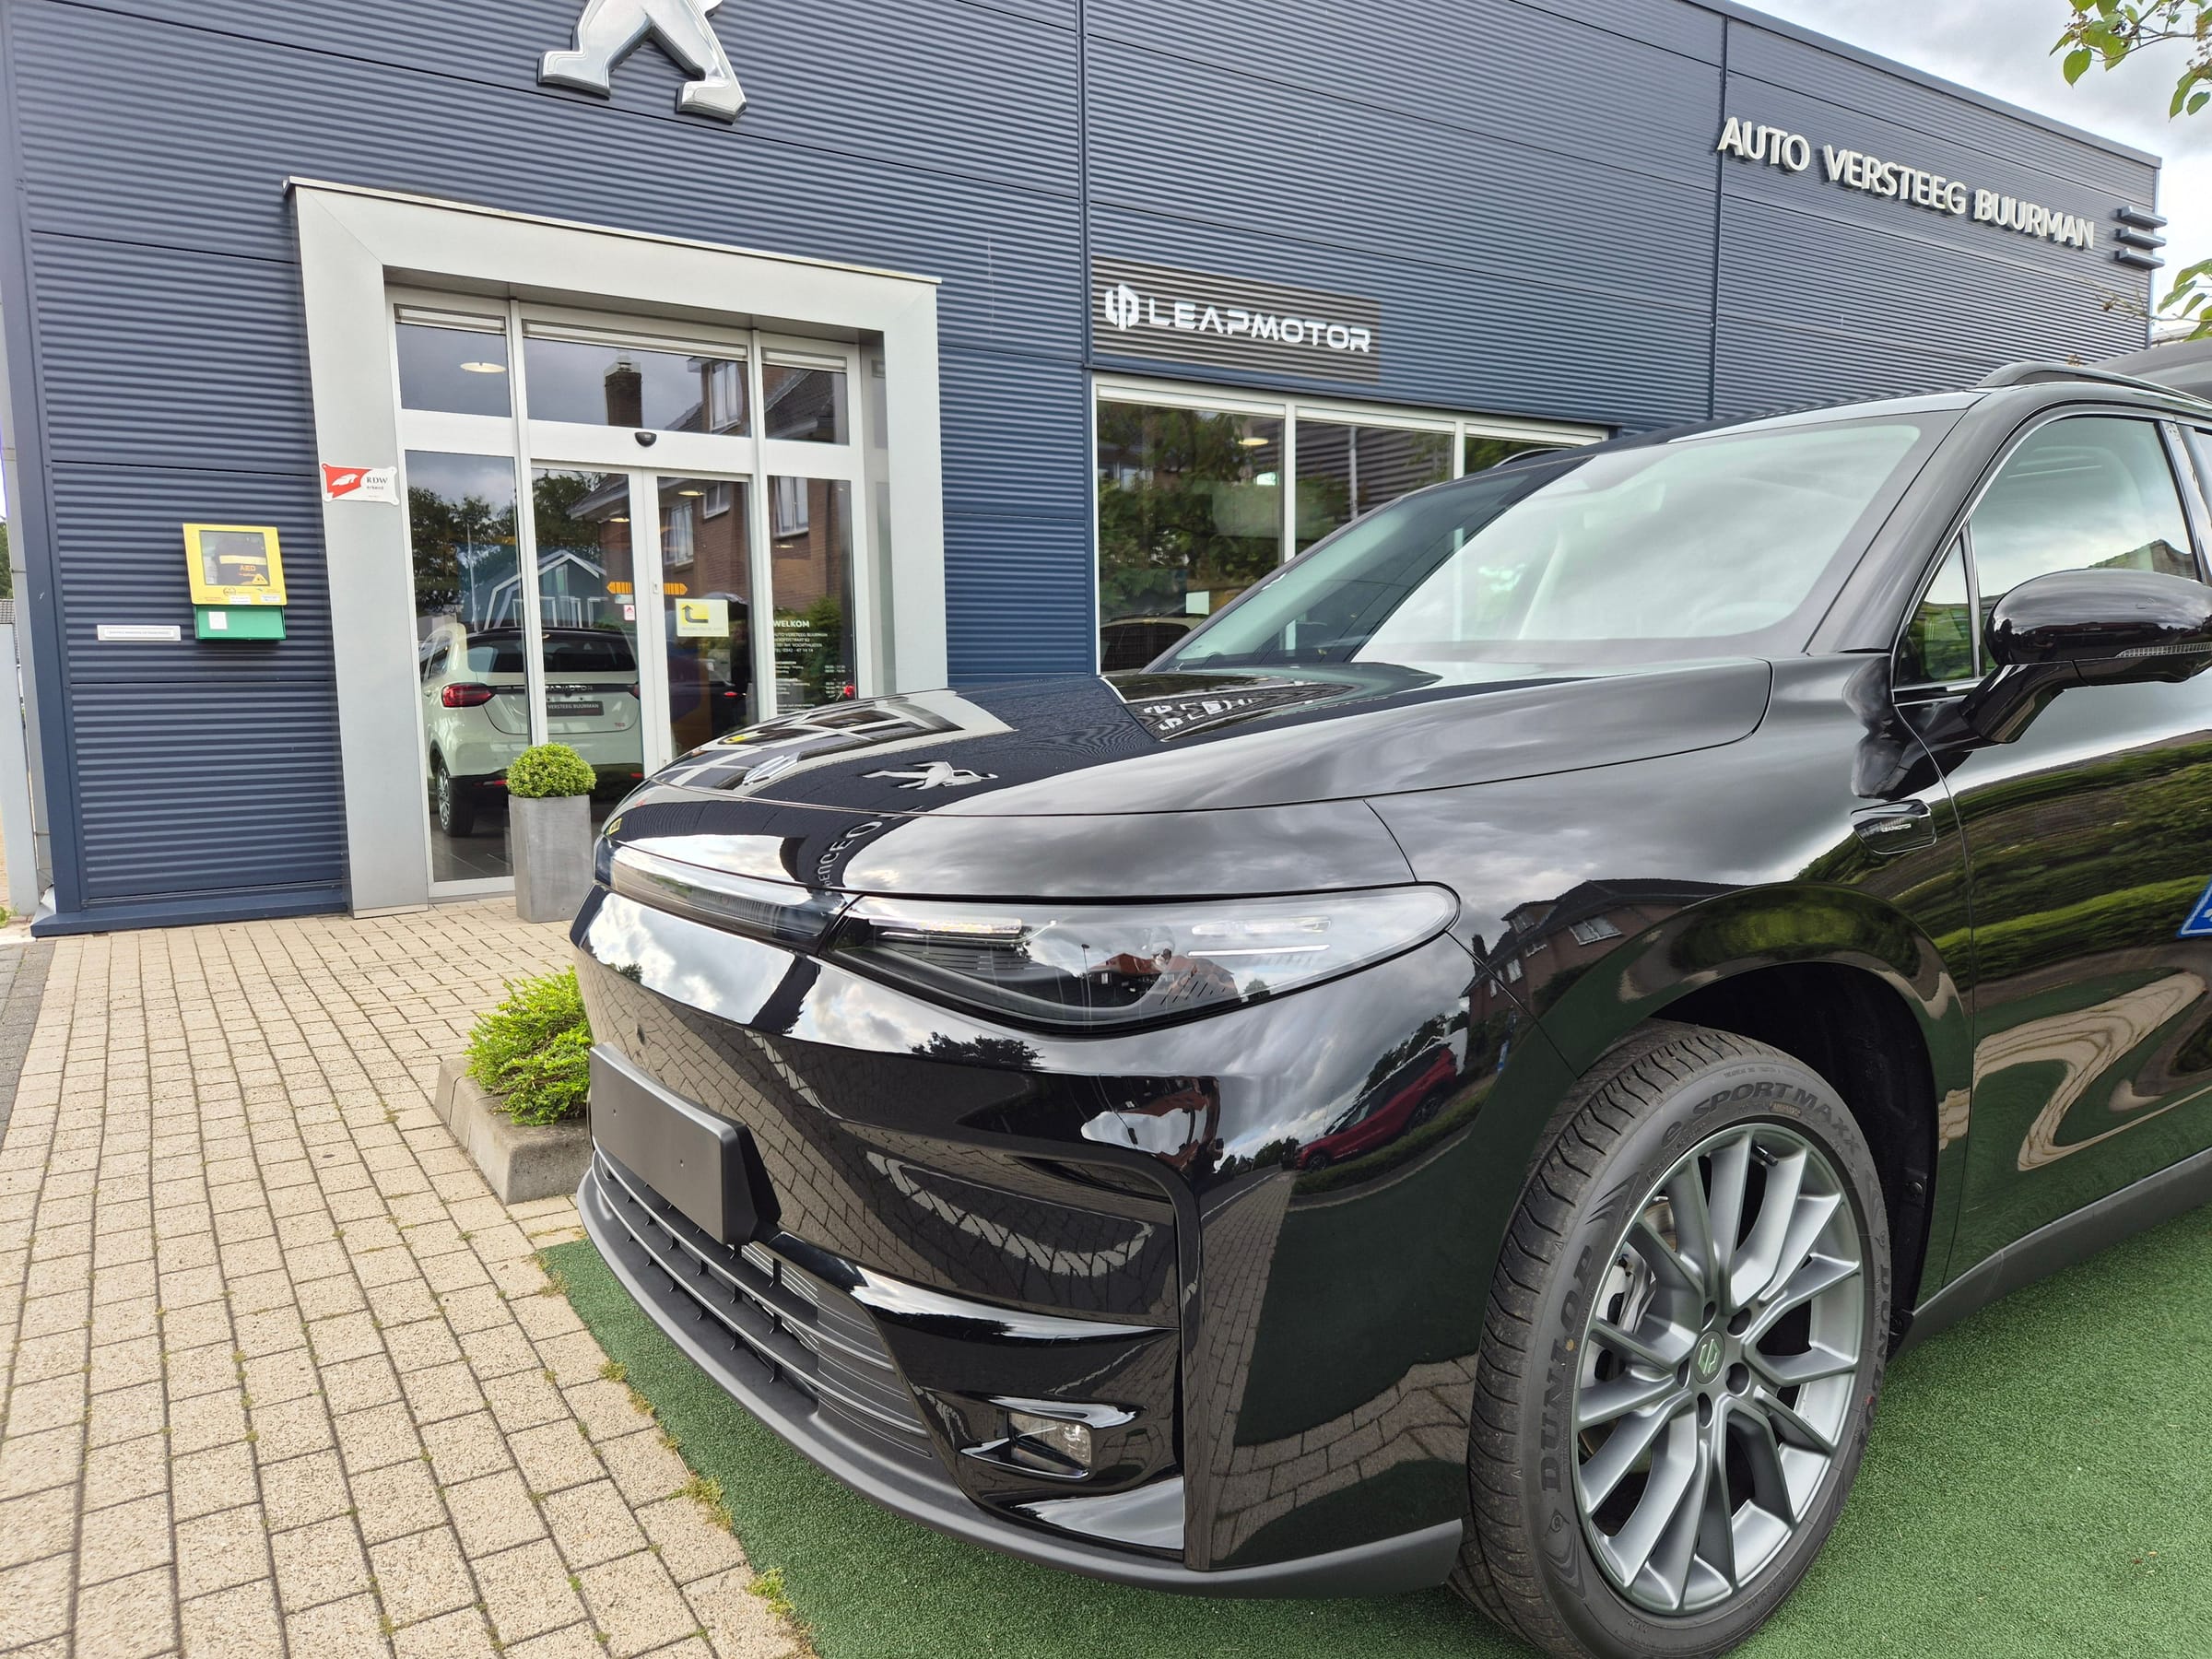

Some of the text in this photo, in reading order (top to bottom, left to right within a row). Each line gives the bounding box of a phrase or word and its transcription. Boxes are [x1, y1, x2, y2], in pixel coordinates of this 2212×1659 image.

[1717, 117, 2095, 250] AUTO VERSTEEG BUURMAN
[1148, 298, 1371, 353] LEAPMOTOR
[773, 619, 810, 628] WELKOM
[1540, 1244, 1594, 1493] DUNLOP
